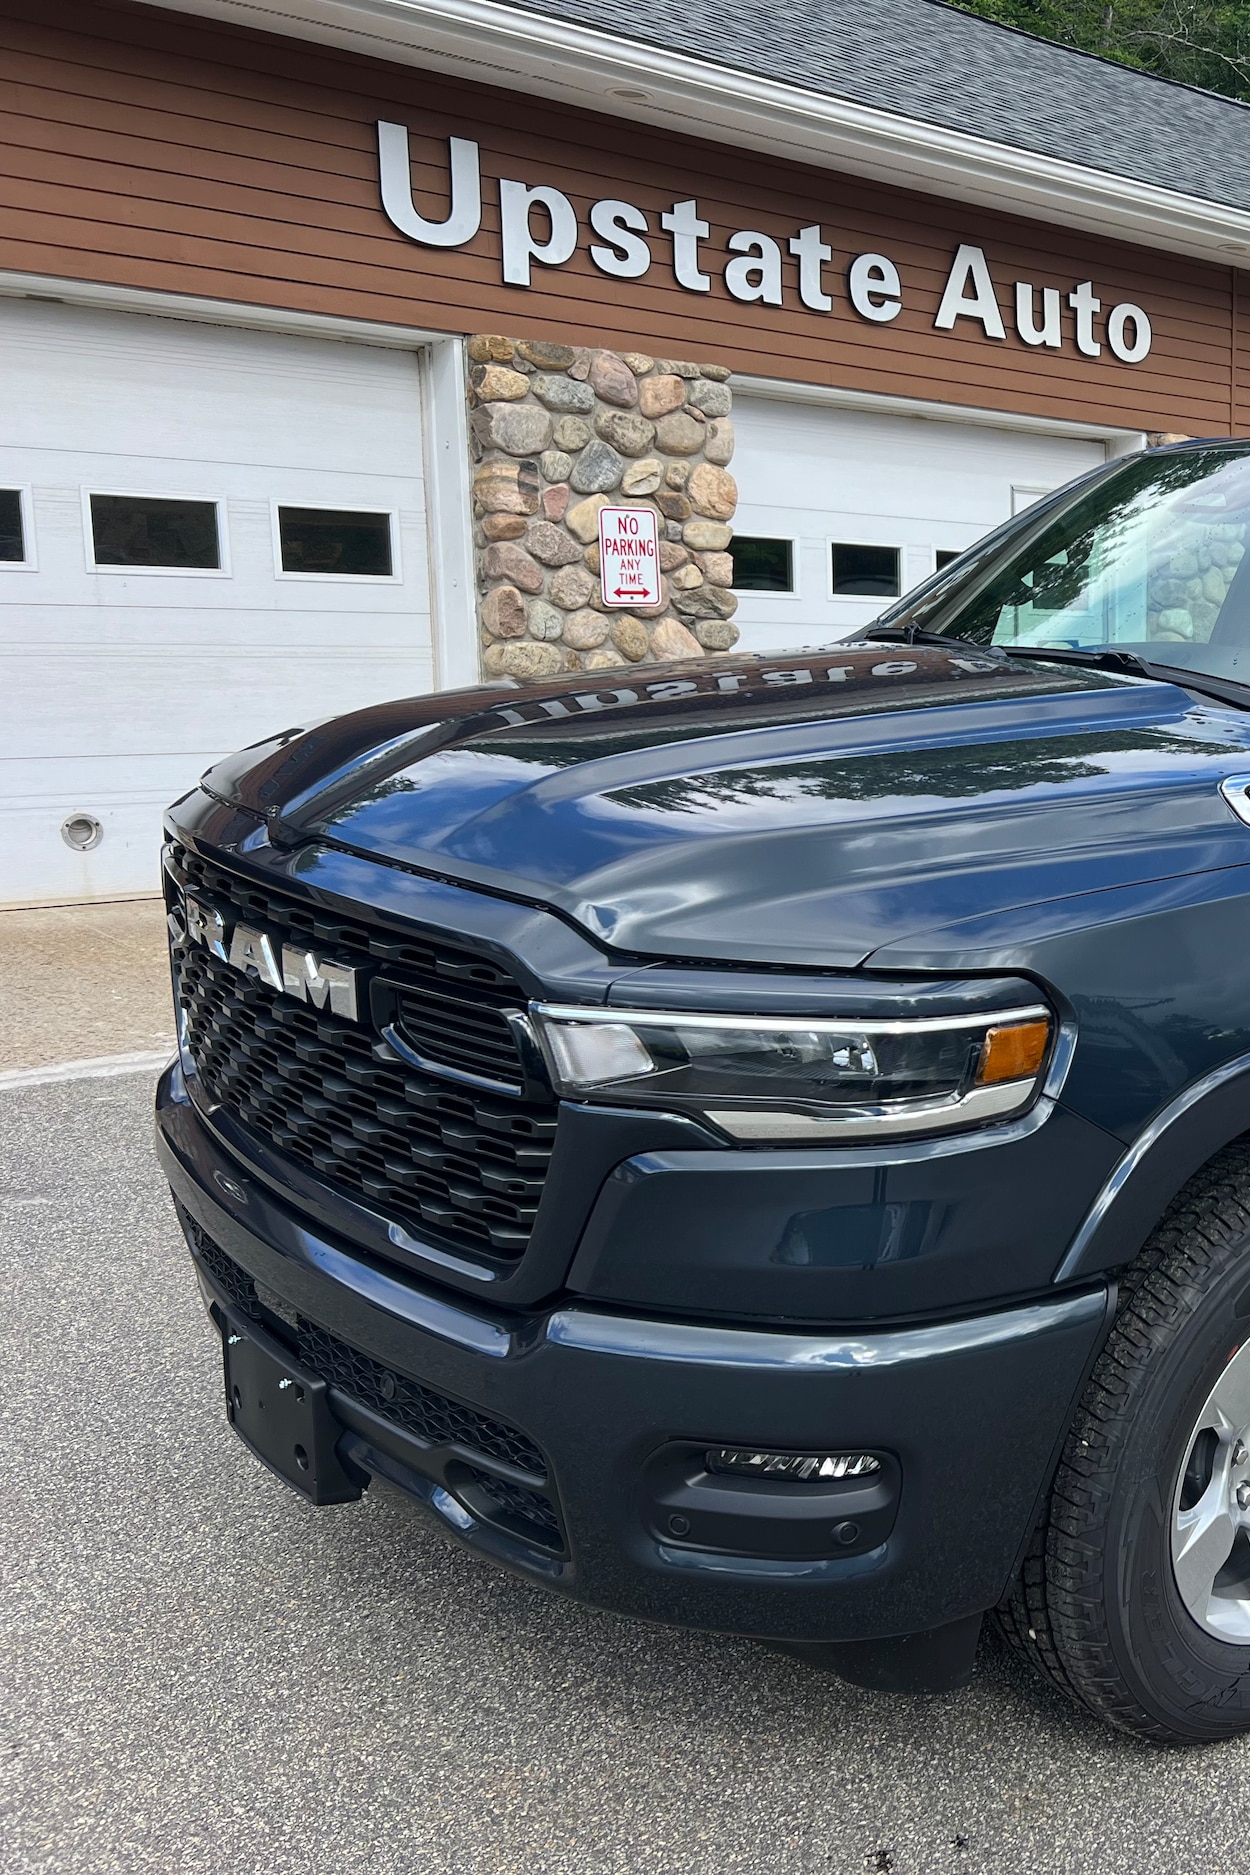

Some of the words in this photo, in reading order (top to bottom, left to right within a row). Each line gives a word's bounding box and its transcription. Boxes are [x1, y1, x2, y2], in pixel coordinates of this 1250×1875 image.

[375, 119, 904, 324] Upstate
[933, 243, 1154, 366] Auto
[617, 516, 639, 535] NO
[605, 538, 654, 557] PARKING
[620, 559, 641, 571] ANY
[619, 573, 644, 585] TIME
[185, 890, 362, 1023] RAM
